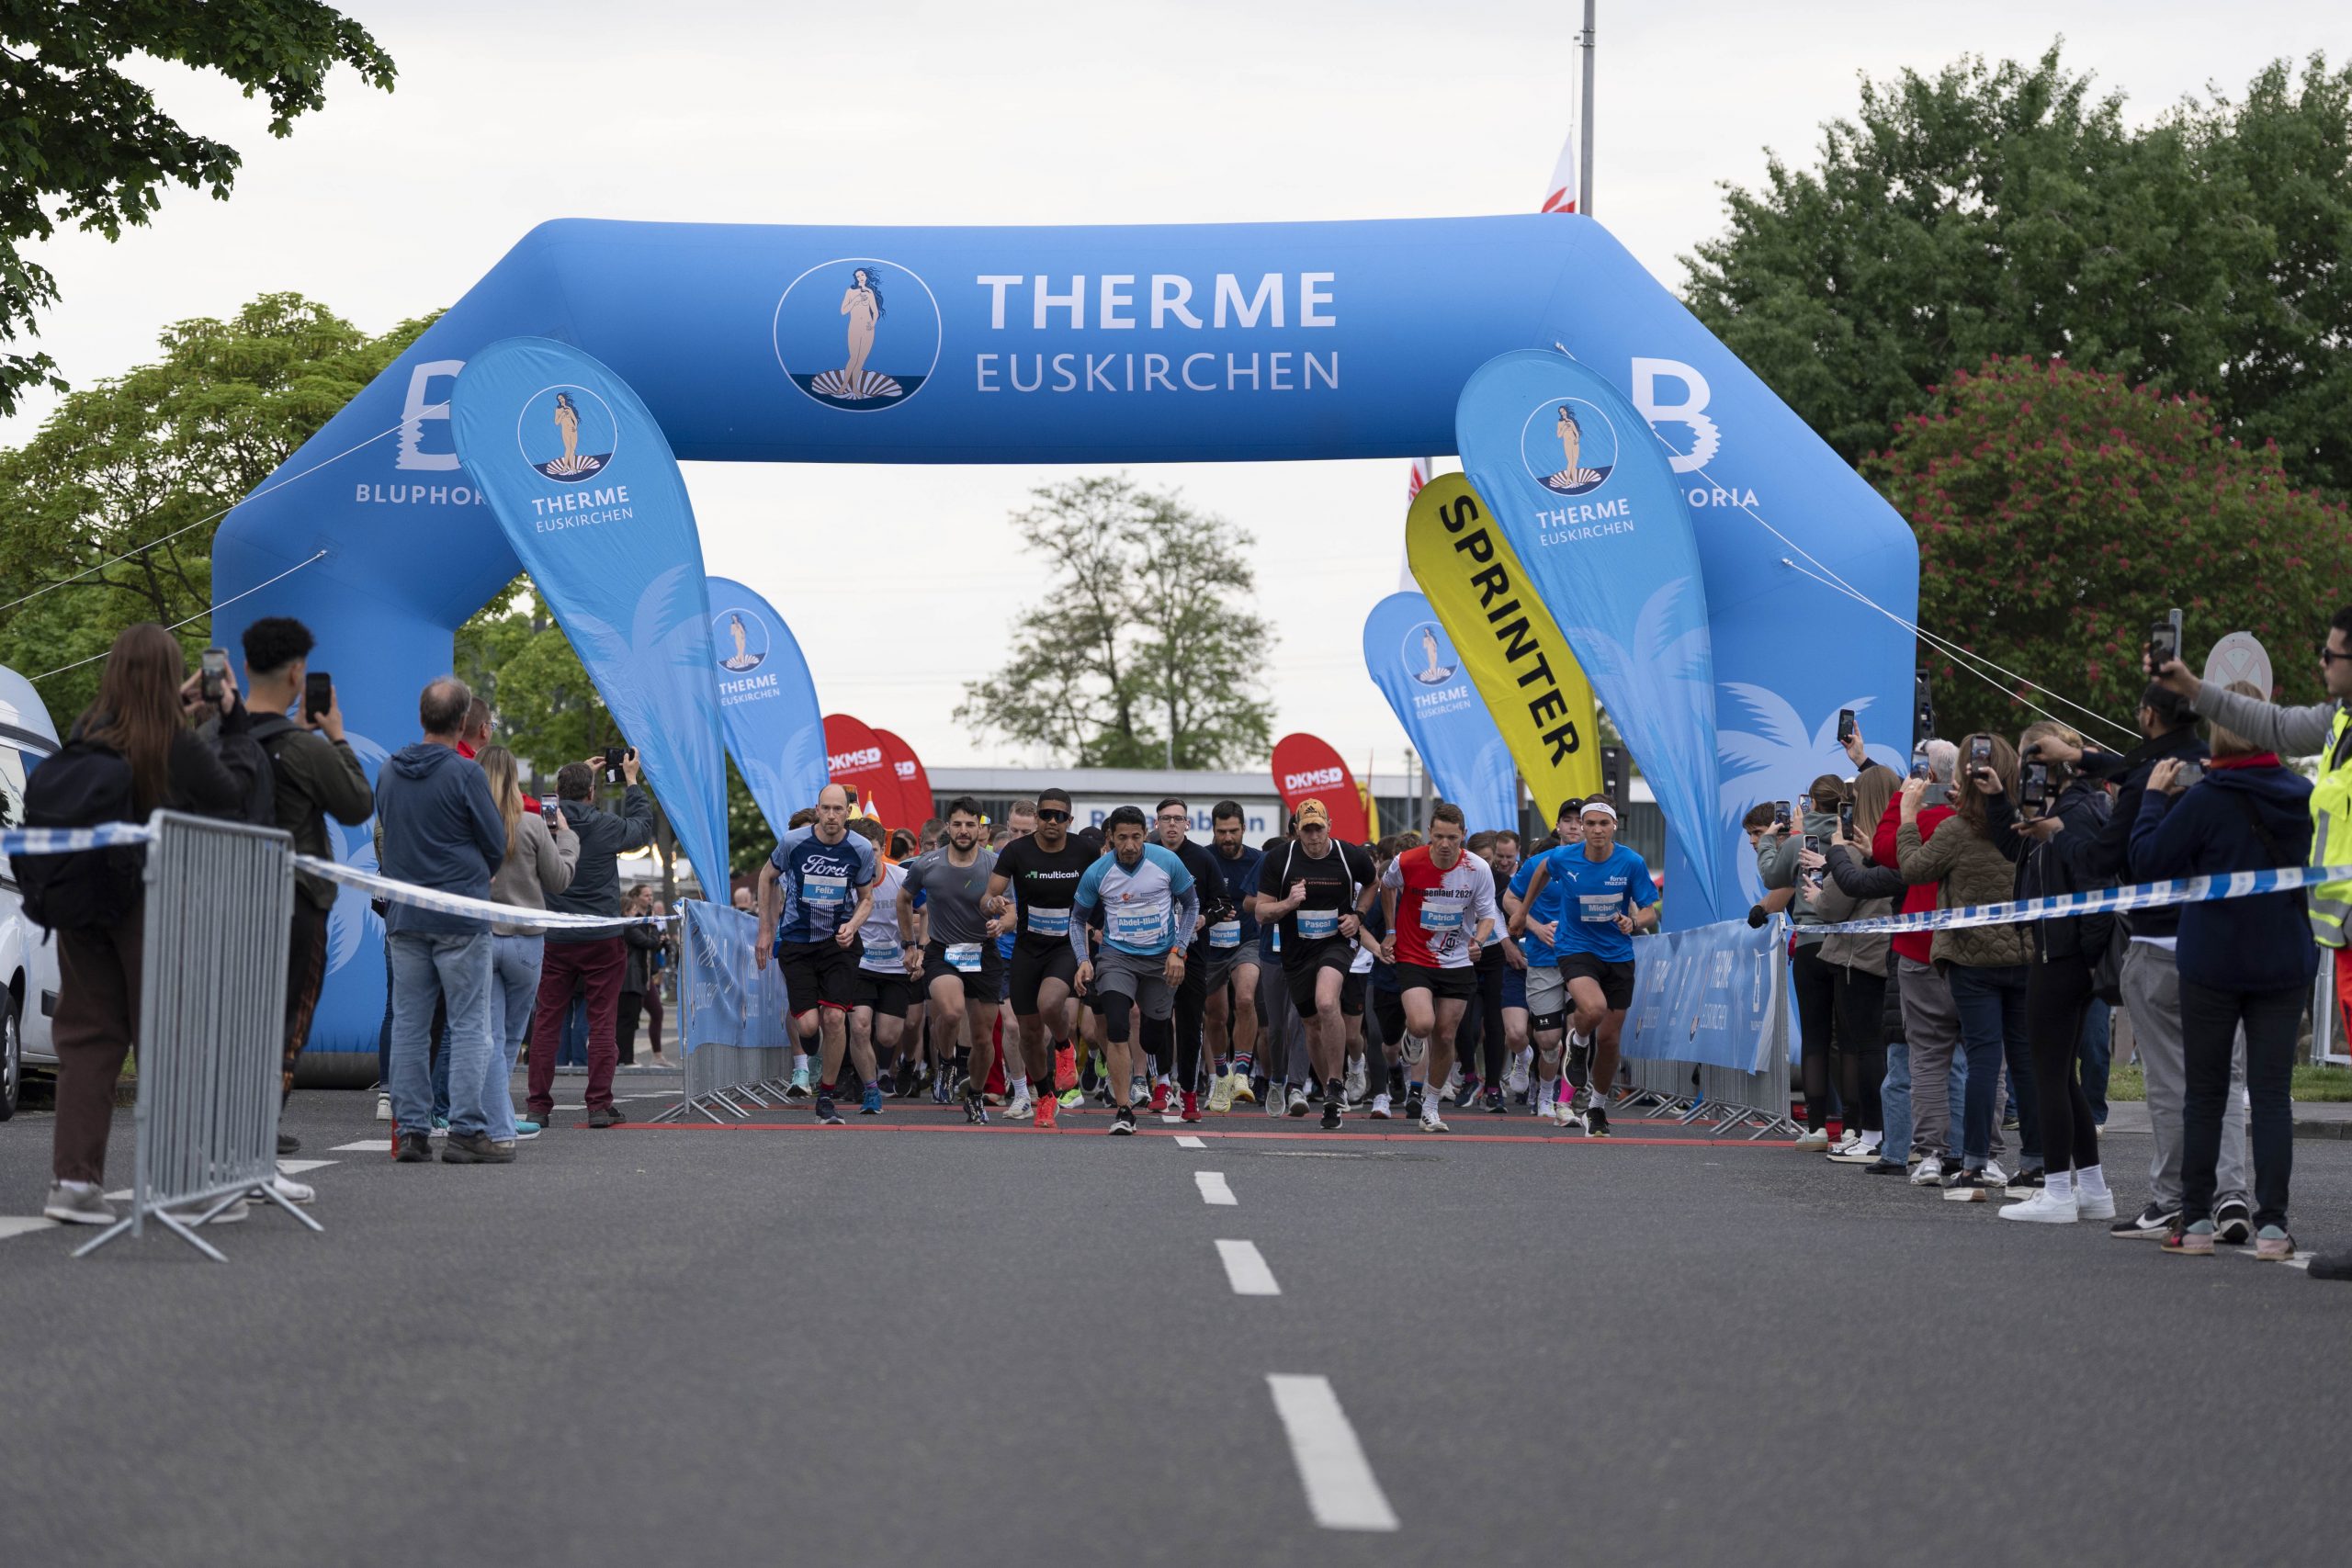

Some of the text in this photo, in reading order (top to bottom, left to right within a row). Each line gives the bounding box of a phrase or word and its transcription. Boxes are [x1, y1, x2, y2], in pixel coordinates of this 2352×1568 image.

[977, 271, 1337, 331] THERME
[977, 351, 1340, 392] EUSKIRCHEN
[531, 485, 630, 516] THERME
[1679, 487, 1760, 507] ORIA
[536, 506, 634, 534] EUSKIRCHEN
[1535, 498, 1632, 530] THERME
[1539, 520, 1634, 547] EUSKIRCHEN
[1439, 494, 1580, 769] SPRINTER
[718, 673, 778, 695] THERME
[720, 687, 780, 706] EUSKIRCHEN
[1412, 685, 1469, 709] THERME
[1416, 700, 1472, 720] EUSKIRCHEN
[1284, 768, 1330, 790] DKMS
[801, 854, 851, 876] Ford
[1039, 869, 1080, 879] multicash
[815, 886, 834, 895] Felix
[1412, 887, 1454, 897] menlauf
[1118, 914, 1160, 927] Abdel-Illah
[1305, 919, 1331, 929] Pascal
[1428, 912, 1455, 921] Patrick
[865, 948, 892, 956] Joshua
[946, 952, 979, 964] Christoph
